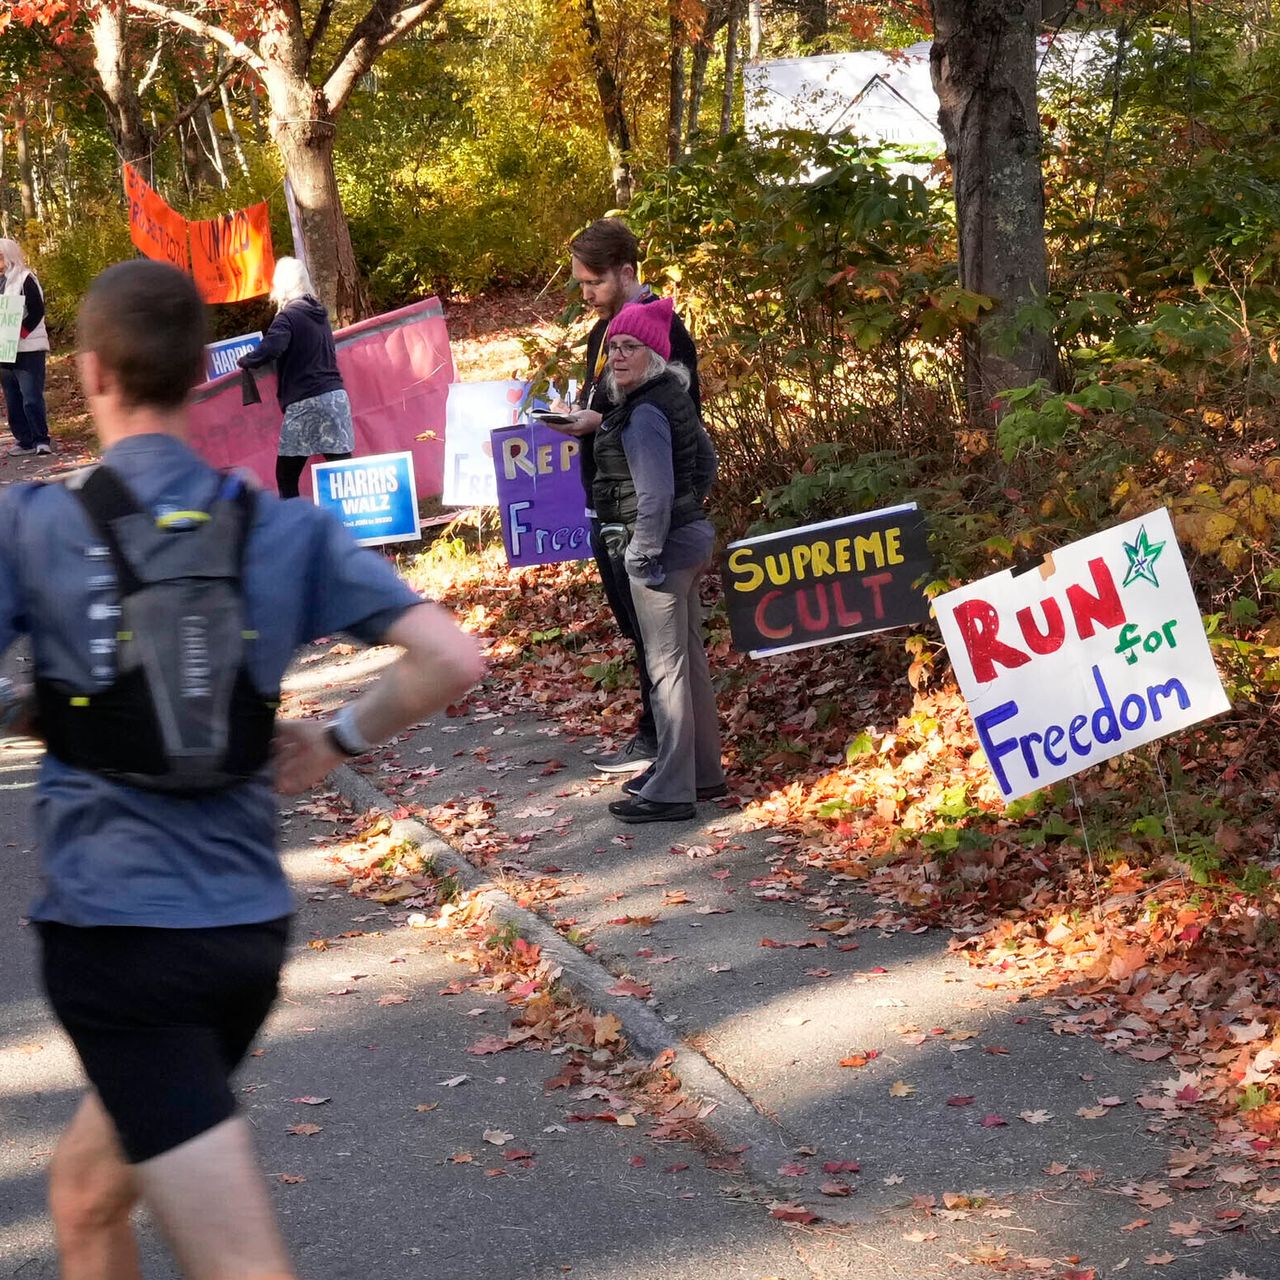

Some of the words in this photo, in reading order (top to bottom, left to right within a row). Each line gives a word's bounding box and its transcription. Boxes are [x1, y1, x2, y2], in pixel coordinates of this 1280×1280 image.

[329, 464, 399, 499] HARRIS
[342, 494, 391, 515] WALZ
[727, 527, 906, 592] SUPREME
[754, 572, 893, 639] CULT
[952, 556, 1126, 684] RUN
[1114, 618, 1177, 665] for
[974, 664, 1192, 796] Freedom
